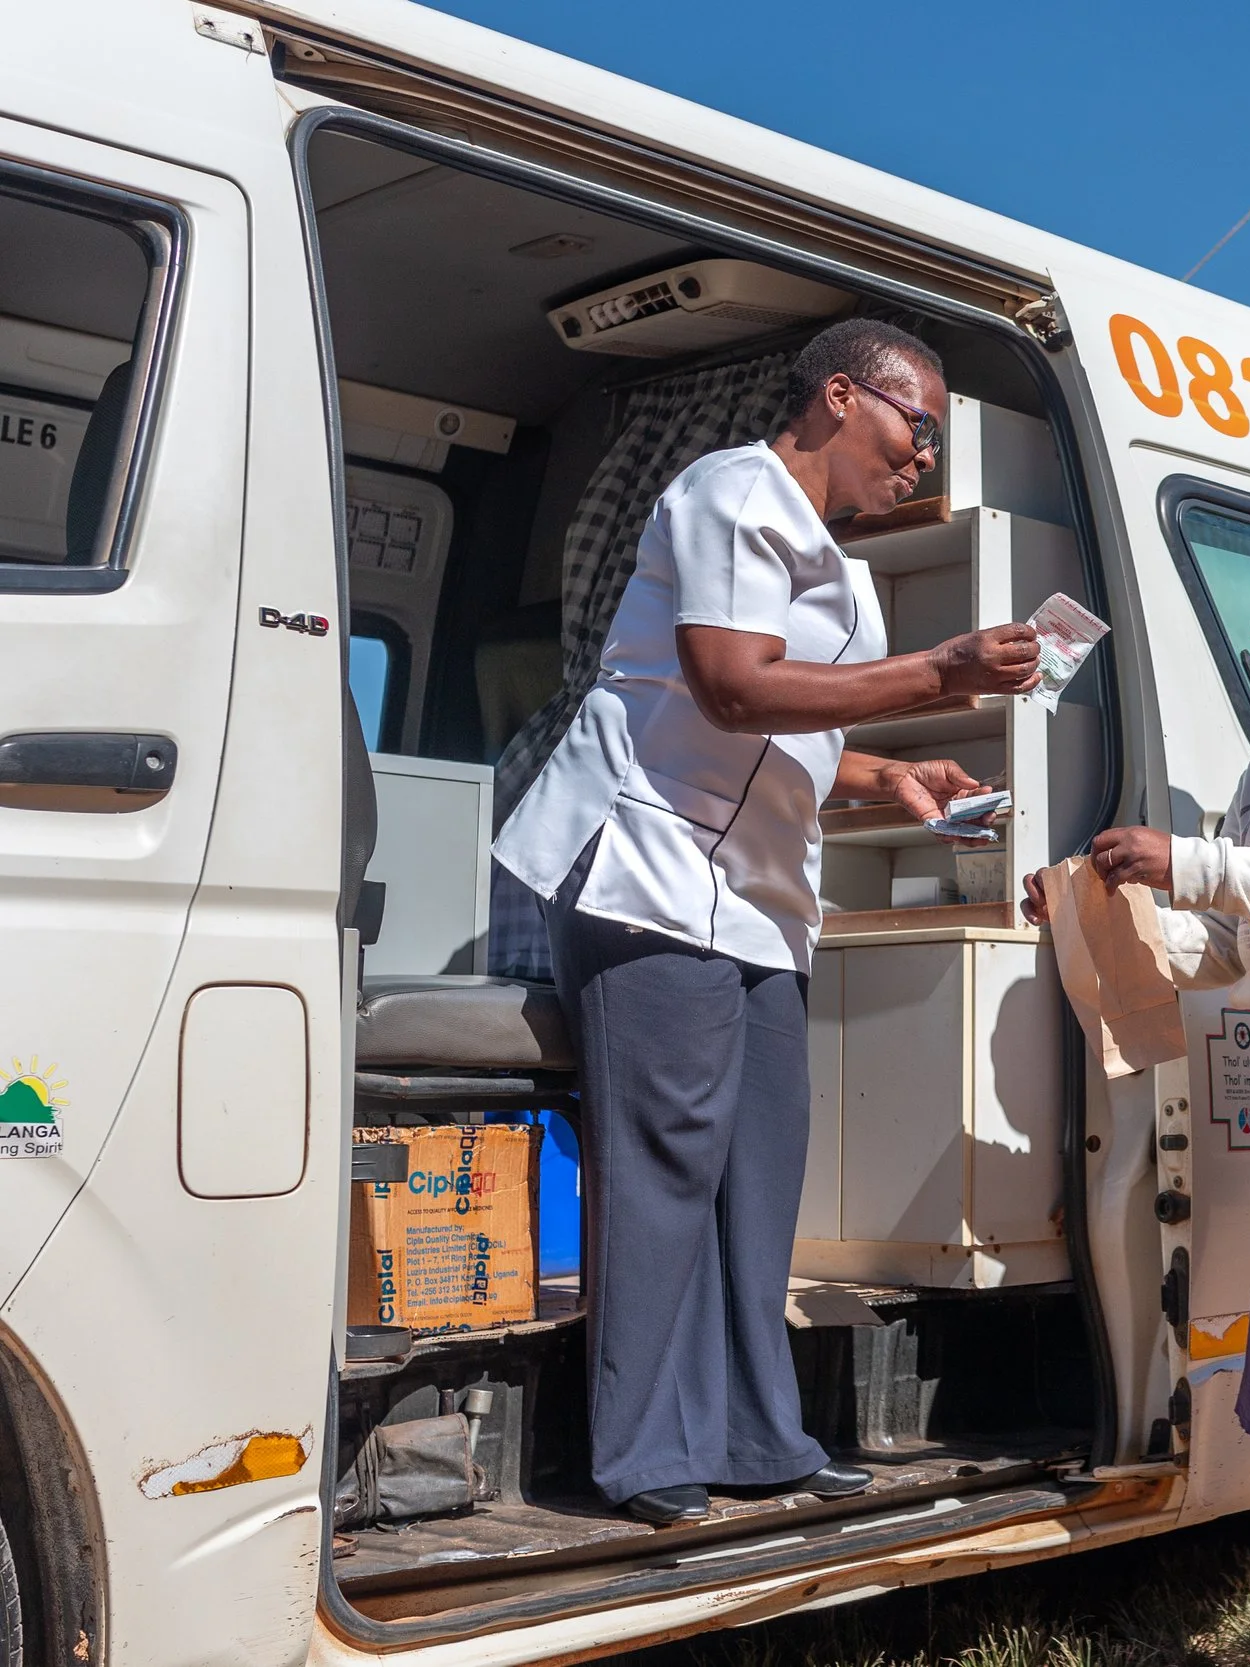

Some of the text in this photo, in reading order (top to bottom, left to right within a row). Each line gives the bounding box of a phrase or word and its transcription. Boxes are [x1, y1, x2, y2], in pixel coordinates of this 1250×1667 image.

[40, 423, 57, 449] 6
[258, 605, 329, 637] D-4D
[24, 1142, 63, 1156] Spirit
[406, 1225, 453, 1235] Manufactured
[406, 1237, 424, 1246] Cipla
[426, 1235, 450, 1244] Quality
[406, 1247, 441, 1255] Industries
[442, 1244, 466, 1253] Limited
[406, 1257, 420, 1266] Plot
[451, 1254, 467, 1263] Ring
[406, 1268, 427, 1277] Luzira
[429, 1265, 460, 1275] Industrial
[424, 1277, 438, 1285] Box
[493, 1269, 518, 1279] Uganda
[421, 1287, 436, 1296] +256
[438, 1285, 450, 1294] 312
